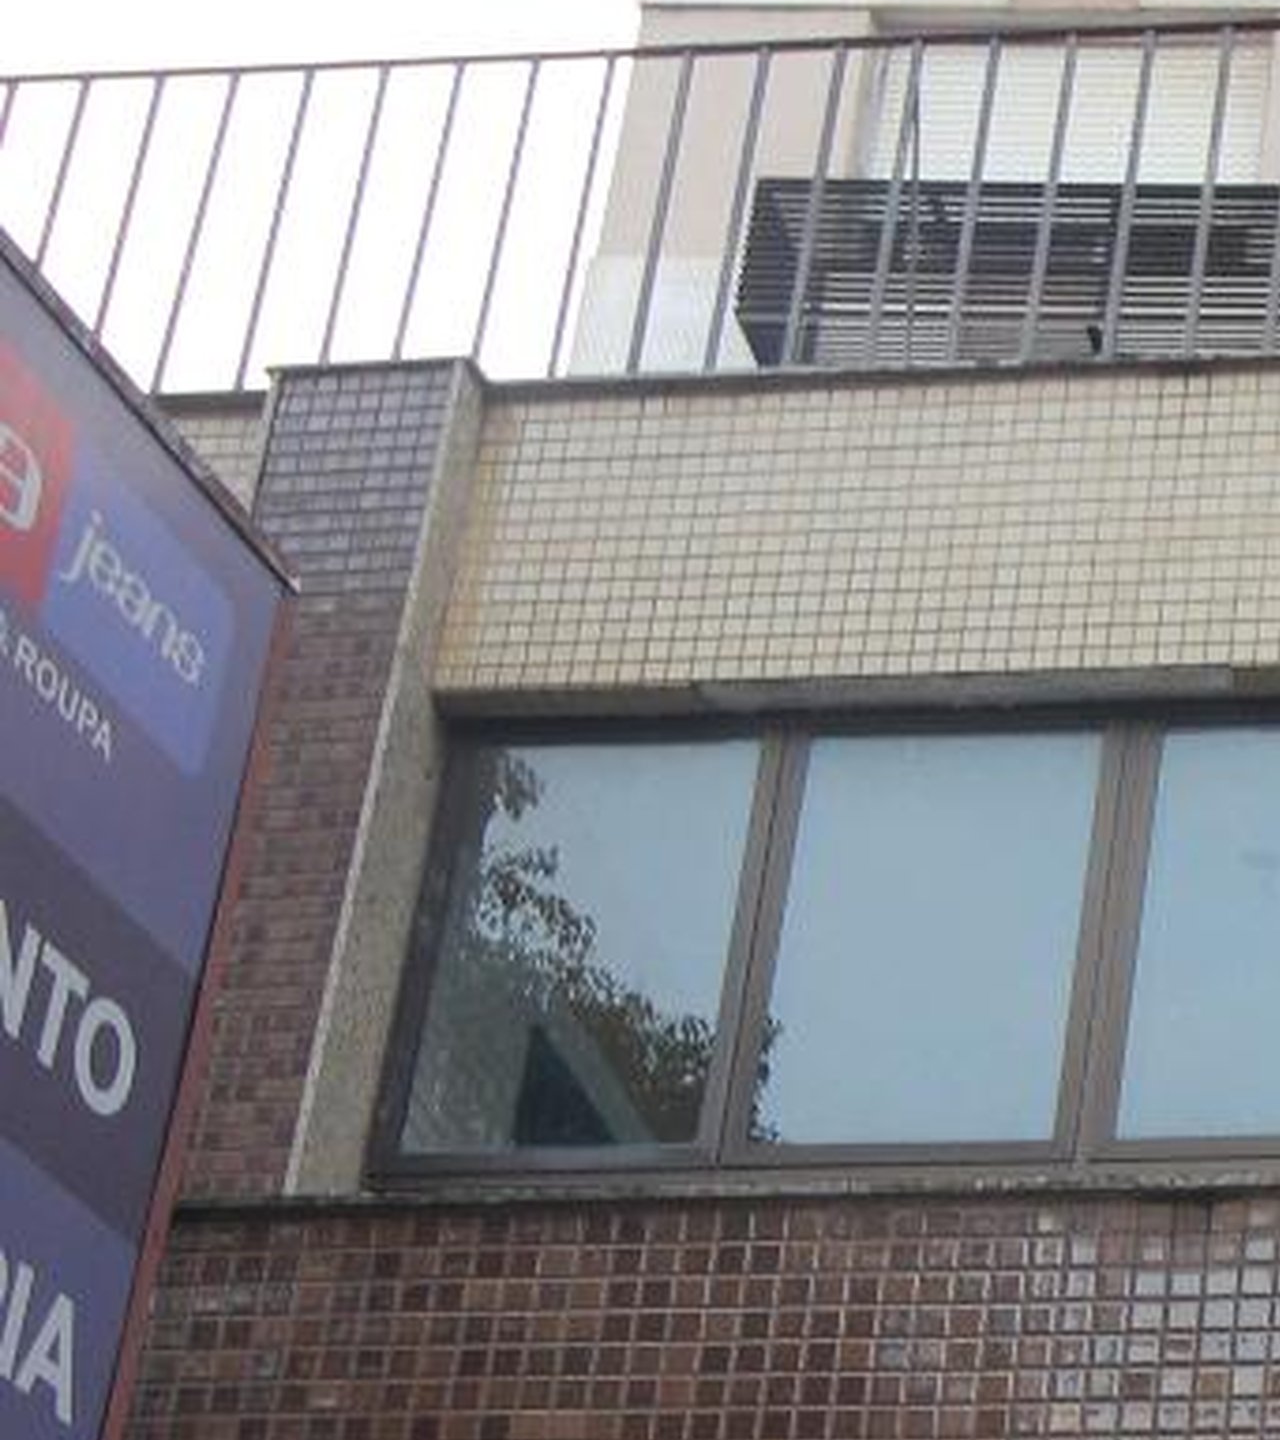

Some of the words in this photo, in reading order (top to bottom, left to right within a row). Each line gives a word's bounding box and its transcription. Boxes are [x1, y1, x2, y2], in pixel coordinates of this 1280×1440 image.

[60, 509, 205, 686] jeans
[14, 633, 112, 763] ROUPA
[0, 1250, 75, 1427] IA
